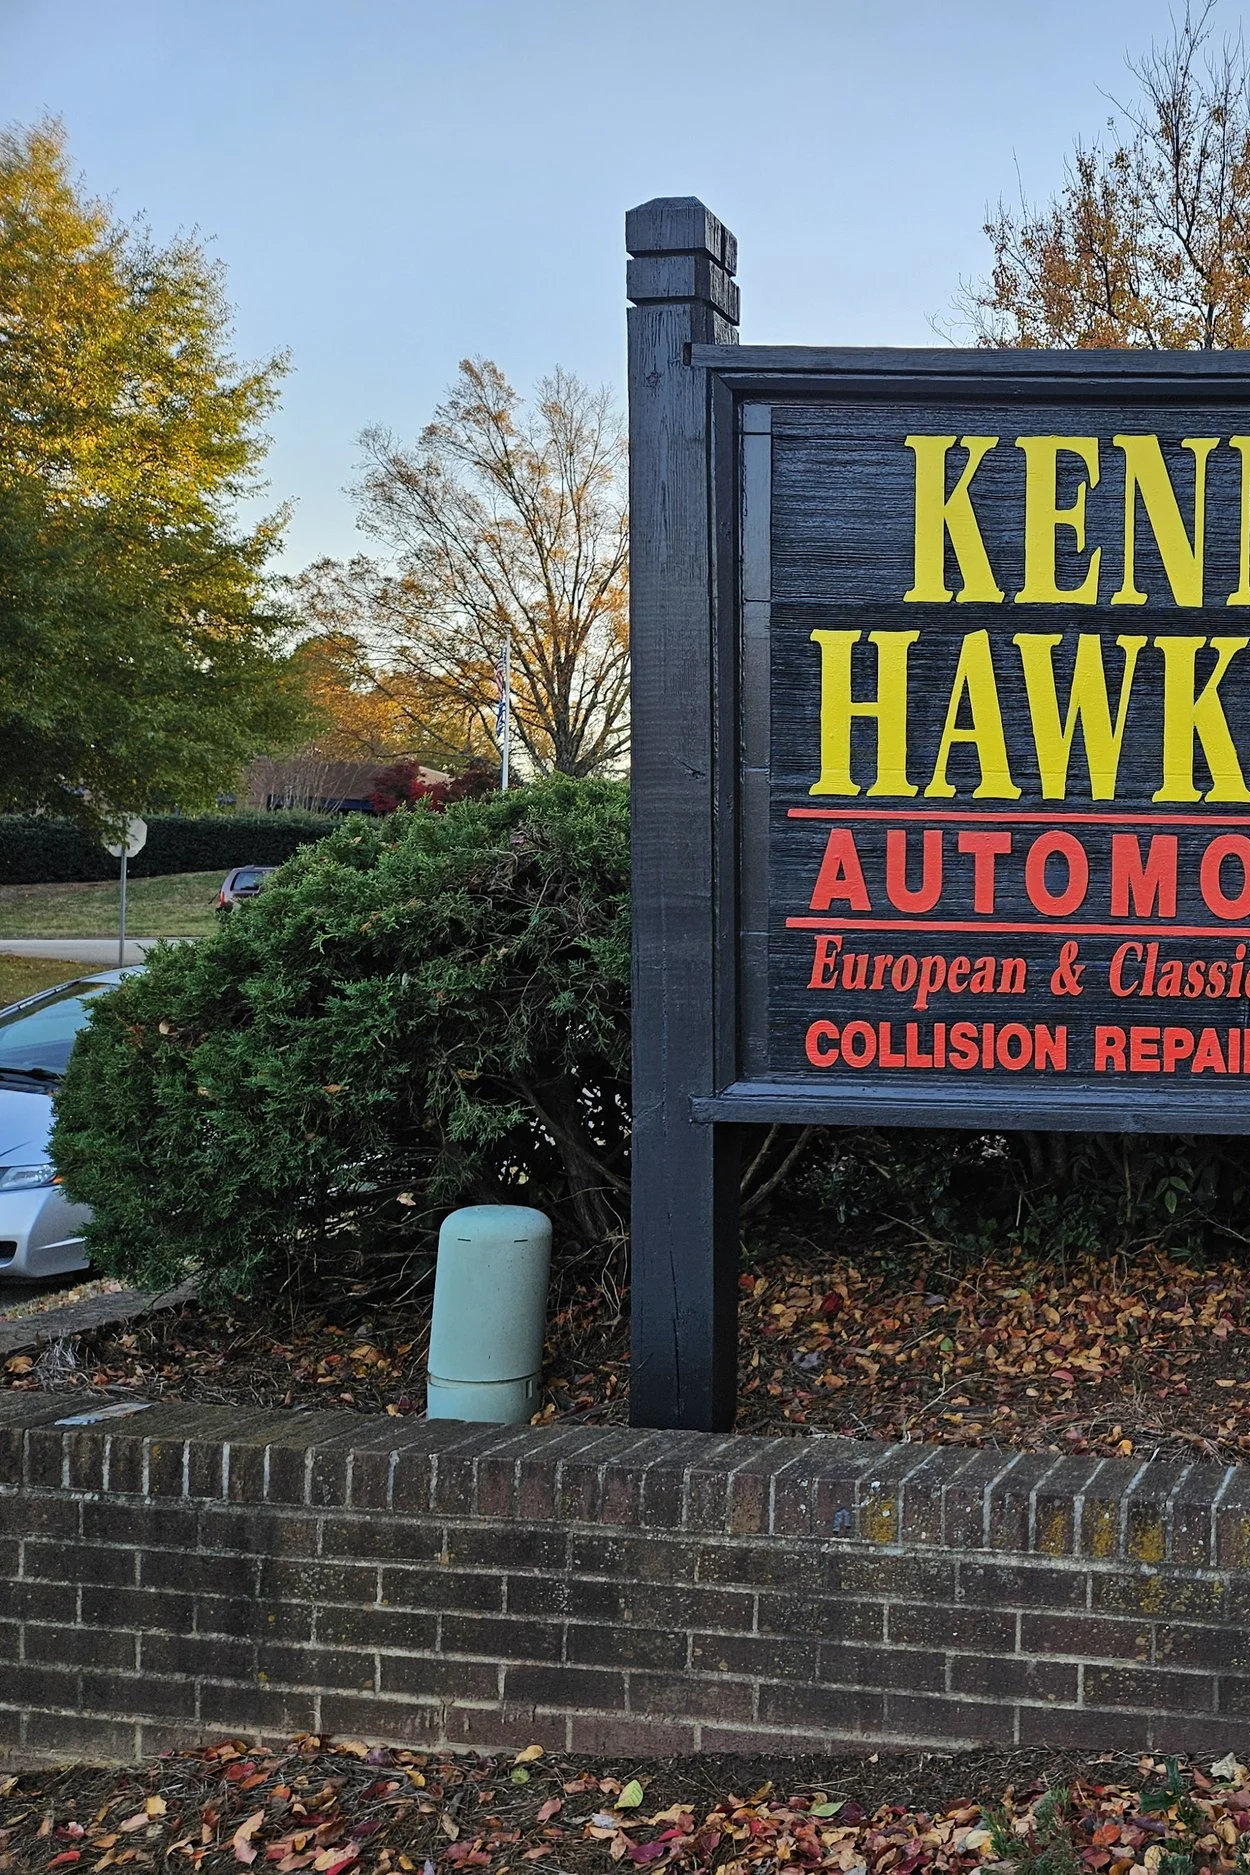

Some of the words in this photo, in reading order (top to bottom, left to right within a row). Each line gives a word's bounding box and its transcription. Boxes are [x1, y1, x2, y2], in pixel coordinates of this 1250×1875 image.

[808, 936, 1028, 1011] European
[1050, 942, 1085, 997] &
[805, 1021, 1068, 1071] COLLISION
